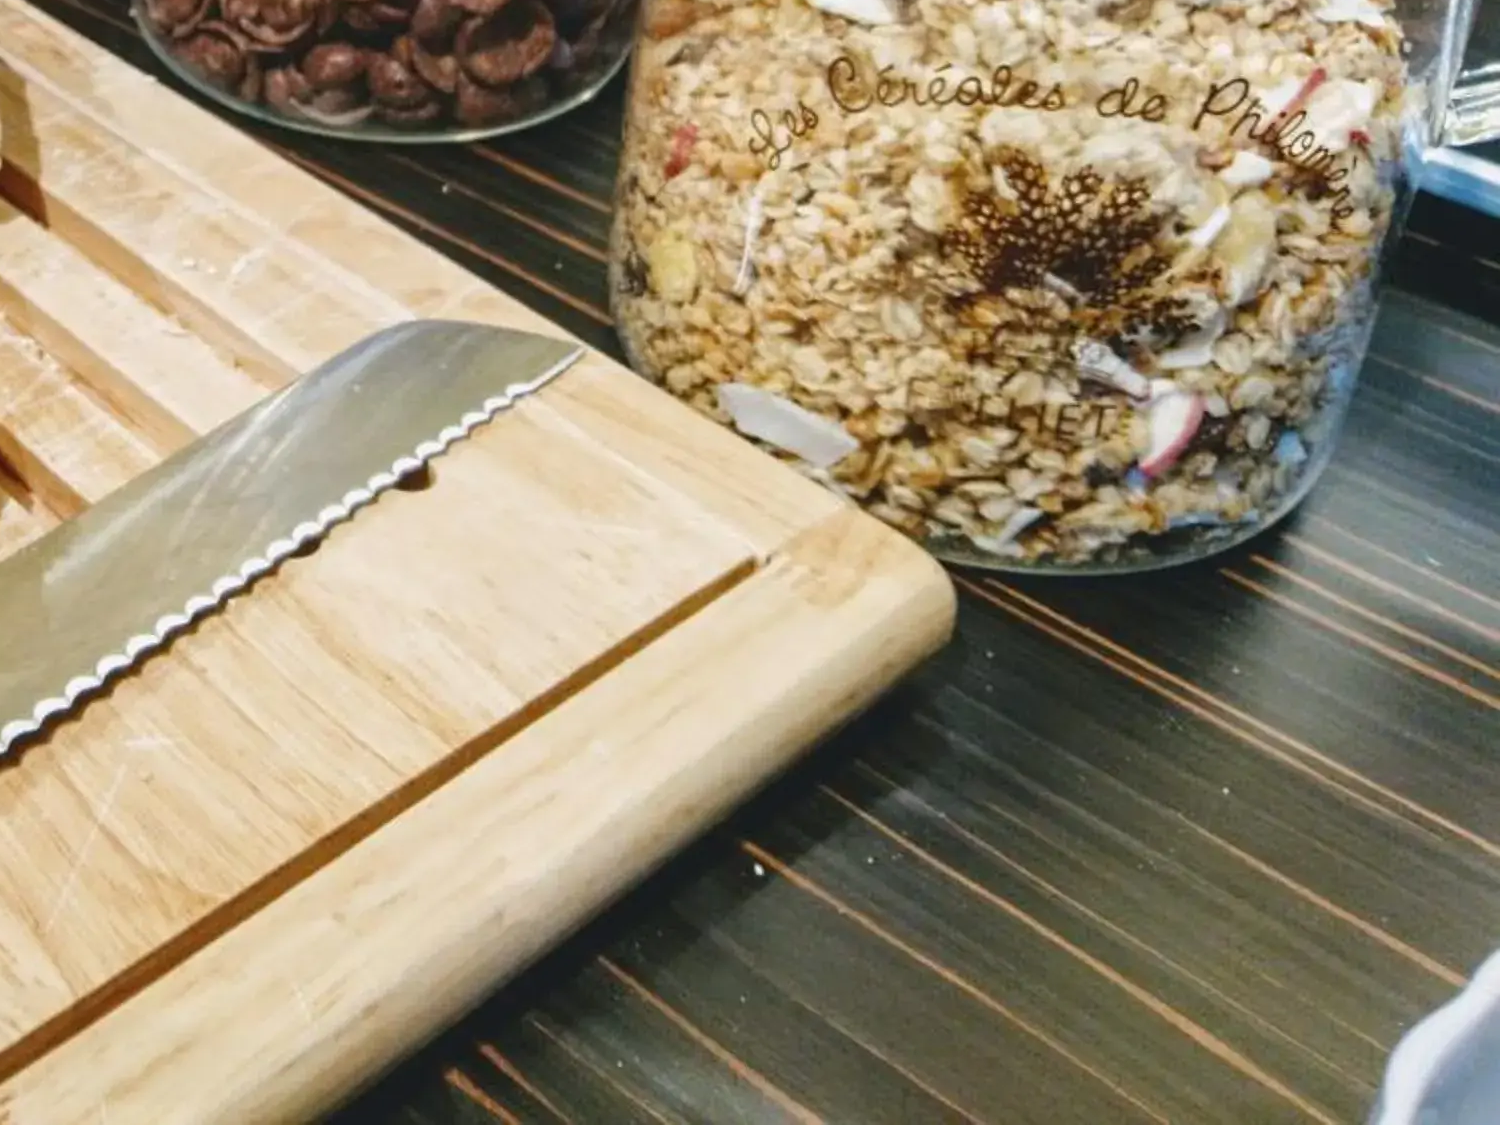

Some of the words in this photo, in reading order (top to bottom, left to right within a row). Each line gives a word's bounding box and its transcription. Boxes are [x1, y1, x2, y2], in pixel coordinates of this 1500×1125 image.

[749, 101, 819, 170] Les
[828, 57, 1066, 113] Céréales
[1096, 77, 1167, 122] de
[1192, 77, 1358, 225] Philomène
